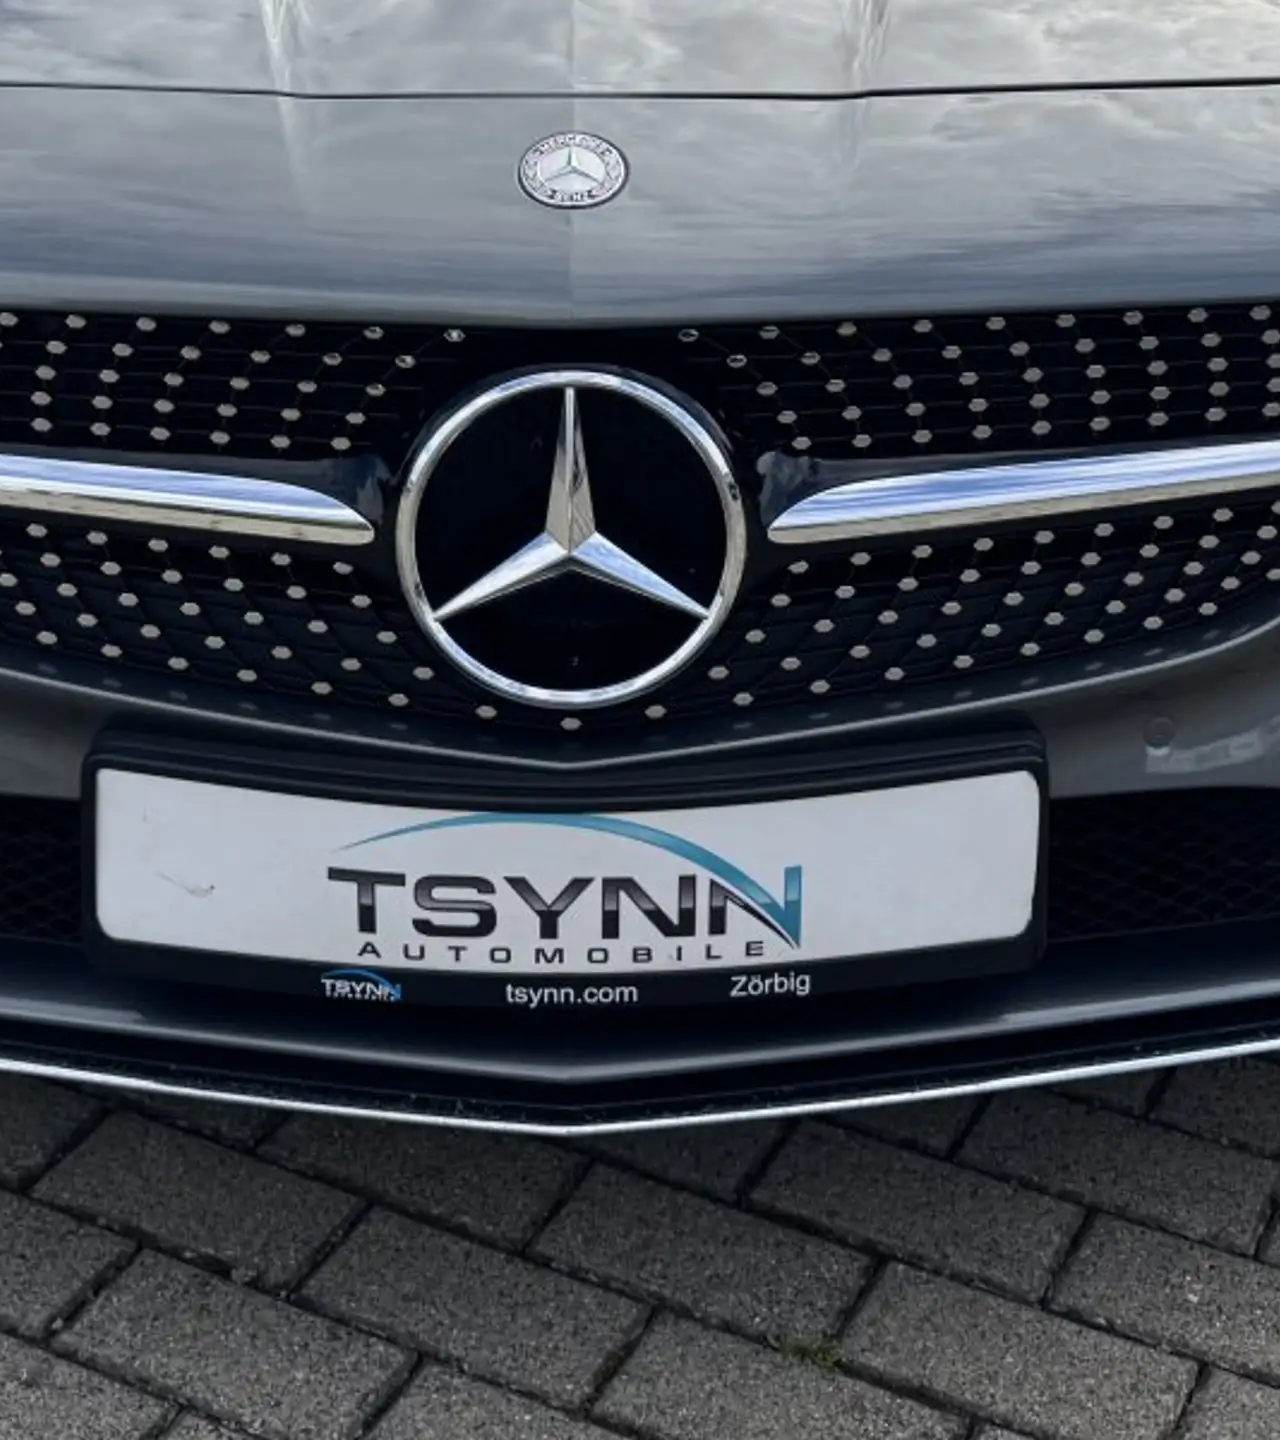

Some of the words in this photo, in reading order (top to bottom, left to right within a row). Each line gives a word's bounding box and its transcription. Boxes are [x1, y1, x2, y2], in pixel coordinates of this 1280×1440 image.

[328, 864, 803, 949] TSYNN
[357, 940, 765, 965] AUTOMOBILE
[505, 982, 639, 1007] tsynn.com
[730, 971, 811, 998] Zörbig
